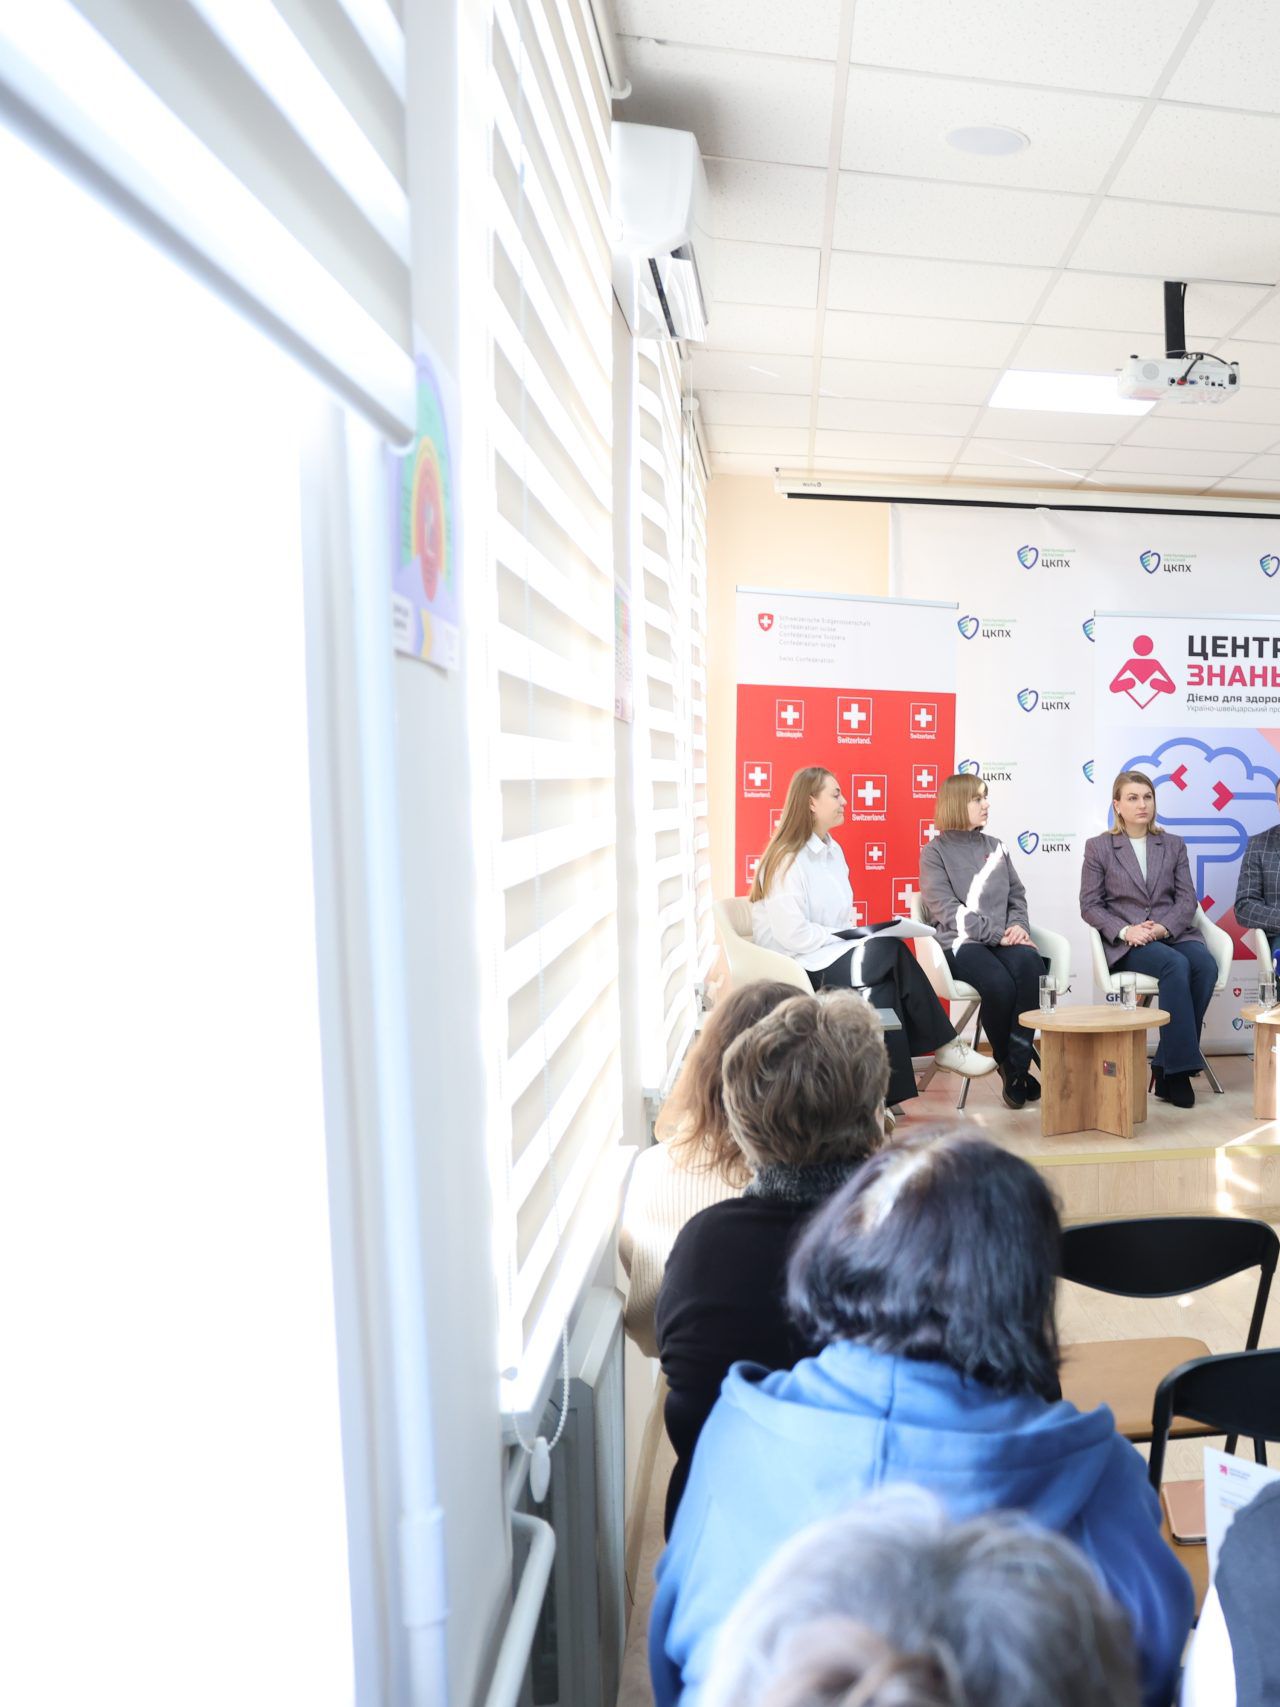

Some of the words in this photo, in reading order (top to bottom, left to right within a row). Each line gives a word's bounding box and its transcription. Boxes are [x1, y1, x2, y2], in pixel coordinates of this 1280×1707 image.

[1041, 559, 1071, 569] ЦКПХ
[1163, 564, 1192, 573] ЦКПХ
[982, 629, 1011, 639] ЦКПХ
[1187, 693, 1219, 703] Діємо
[1221, 695, 1243, 704] для
[1041, 701, 1071, 711] ЦКПХ
[1187, 704, 1268, 713] Україно-швейцарський
[837, 736, 872, 745] Switzerland.
[983, 773, 1012, 782] ЦКПХ
[852, 813, 886, 822] Switzerland.
[1041, 844, 1071, 853] ЦКПХ
